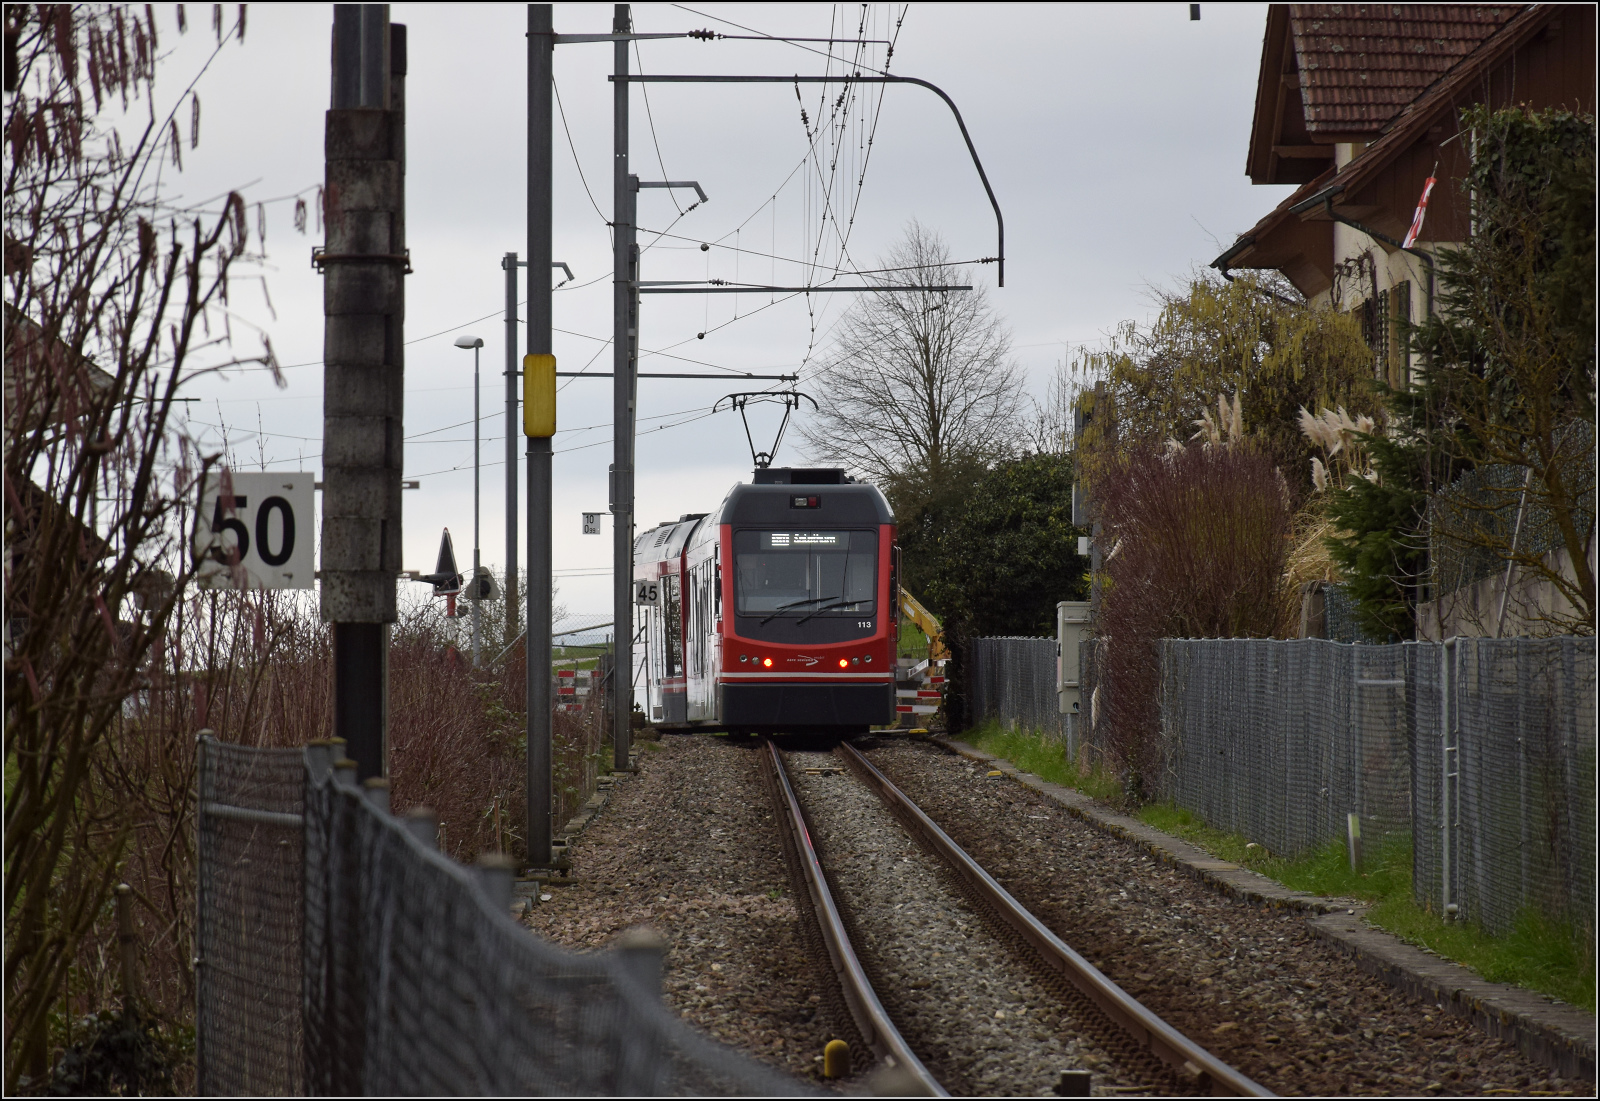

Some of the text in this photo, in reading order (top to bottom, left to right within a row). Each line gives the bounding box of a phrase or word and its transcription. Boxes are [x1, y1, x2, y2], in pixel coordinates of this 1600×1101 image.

[585, 514, 595, 524] 10
[209, 495, 296, 567] 50
[638, 585, 658, 601] 45
